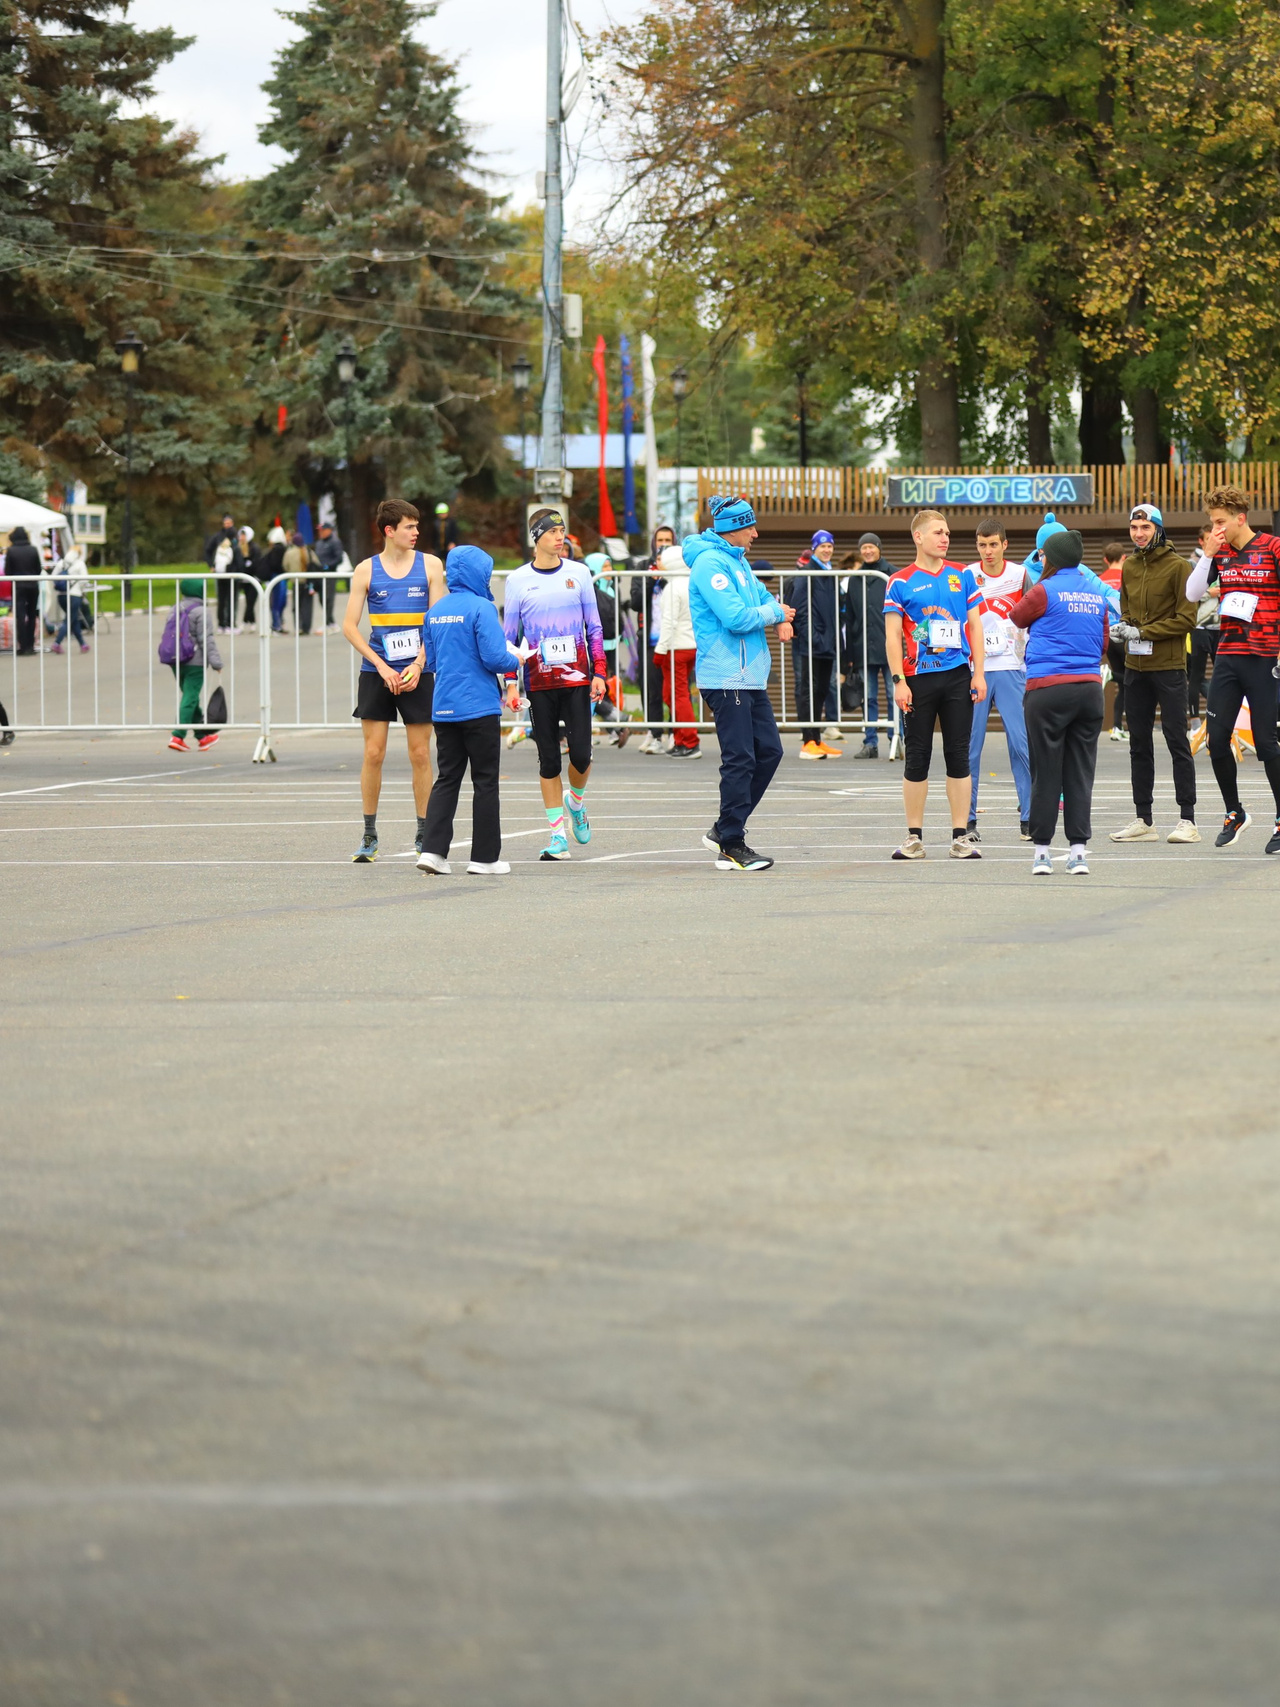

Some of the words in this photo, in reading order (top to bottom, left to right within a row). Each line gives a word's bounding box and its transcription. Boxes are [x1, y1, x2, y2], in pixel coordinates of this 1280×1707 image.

[902, 478, 1077, 503] ИГРОТЕКА
[1240, 569, 1270, 577] WEST
[1058, 591, 1103, 604] УЛЬЯНОВСКАЯ
[1230, 597, 1245, 608] 5.1
[992, 599, 1007, 612] Run
[1068, 602, 1100, 615] ОБЛАСТЬ
[430, 615, 464, 625] RUSSIA
[939, 628, 953, 638] 7.1
[392, 638, 412, 650] 10.1
[985, 636, 1000, 646] 8.1
[551, 643, 567, 653] 9.1
